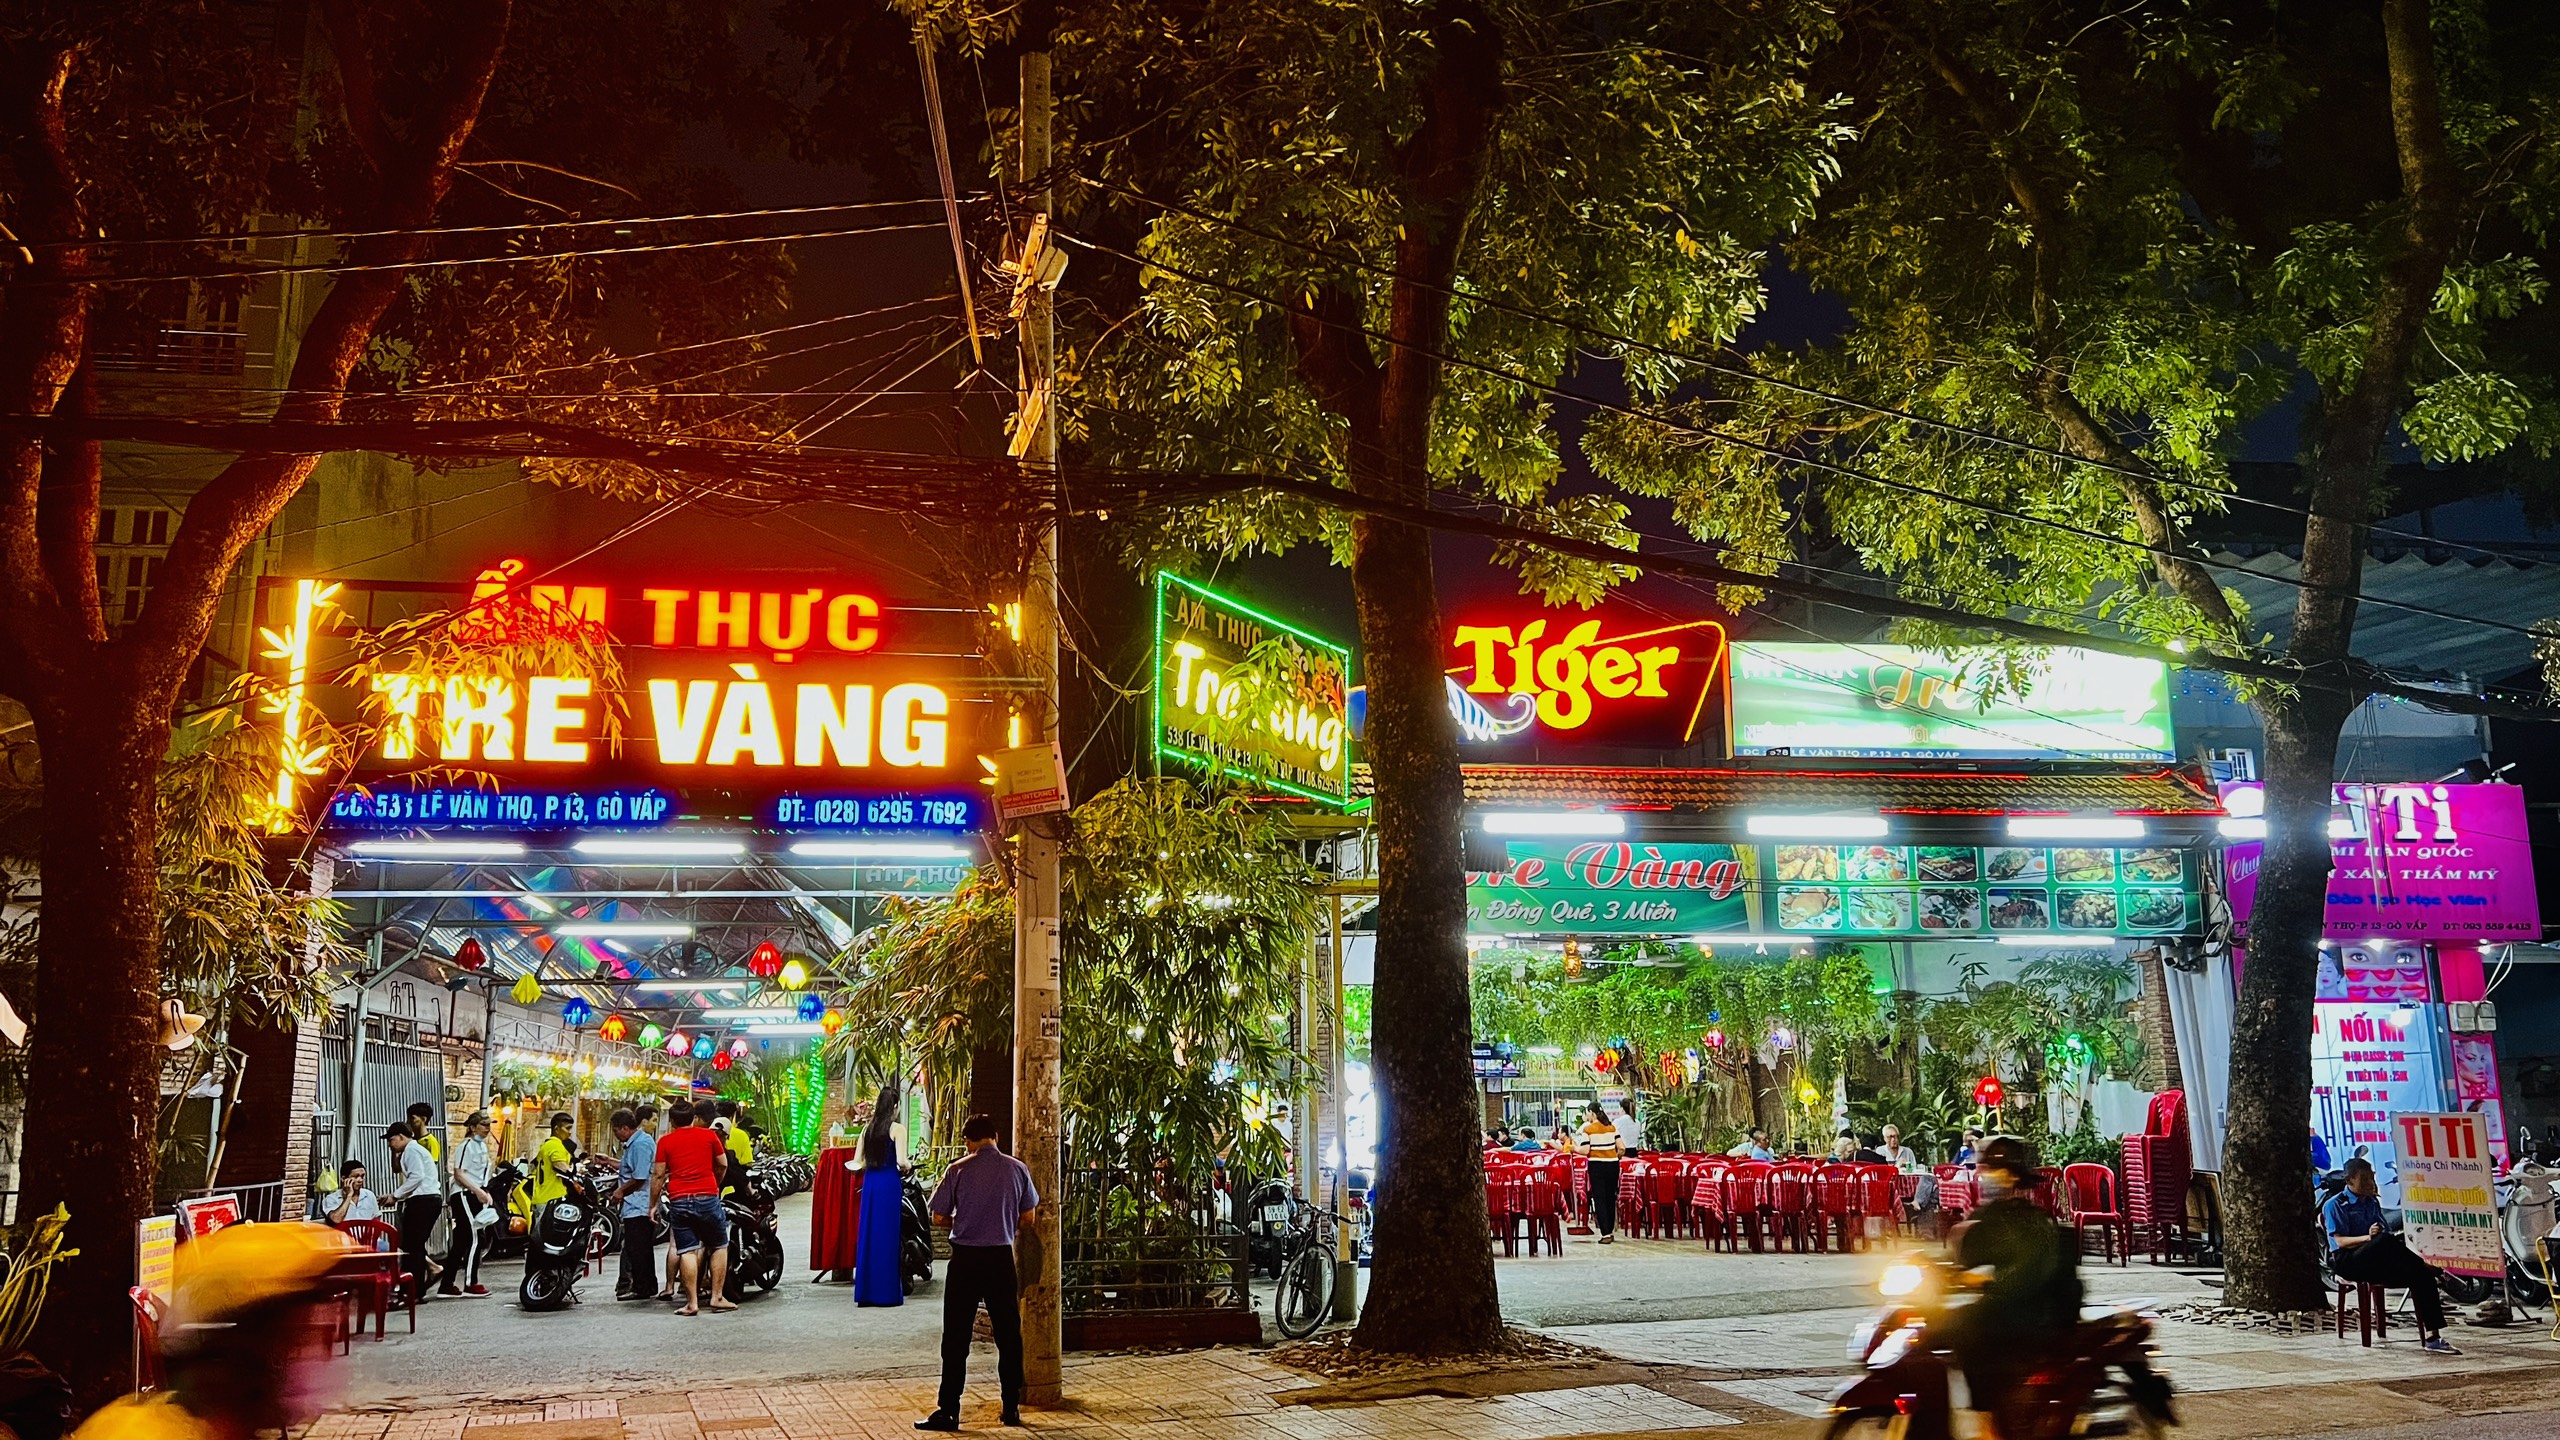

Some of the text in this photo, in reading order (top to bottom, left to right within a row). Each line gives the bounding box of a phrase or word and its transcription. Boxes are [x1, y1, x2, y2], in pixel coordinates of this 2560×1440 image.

[643, 588, 879, 662] THỰC
[1453, 619, 1680, 729] Tiger
[371, 663, 949, 767] TRE VÀNG
[450, 789, 488, 819] VĂN
[597, 790, 622, 820] GÒ
[630, 788, 667, 821] VẤP
[815, 800, 860, 825] (028)
[868, 800, 913, 824] 6295
[922, 801, 967, 825] 7692
[2416, 841, 2474, 859] QUỐC
[1565, 842, 1746, 900] Vàng
[2400, 864, 2462, 880] THẨM
[2467, 866, 2500, 880] MỸ
[1486, 899, 1544, 925] Đồng
[1550, 900, 1597, 923] Quê,
[1602, 901, 1619, 920] 3
[1621, 898, 1678, 922] Miền
[2407, 918, 2428, 930] VẤP
[2339, 1011, 2375, 1042] NỐI
[2405, 1209, 2429, 1225] PHUN
